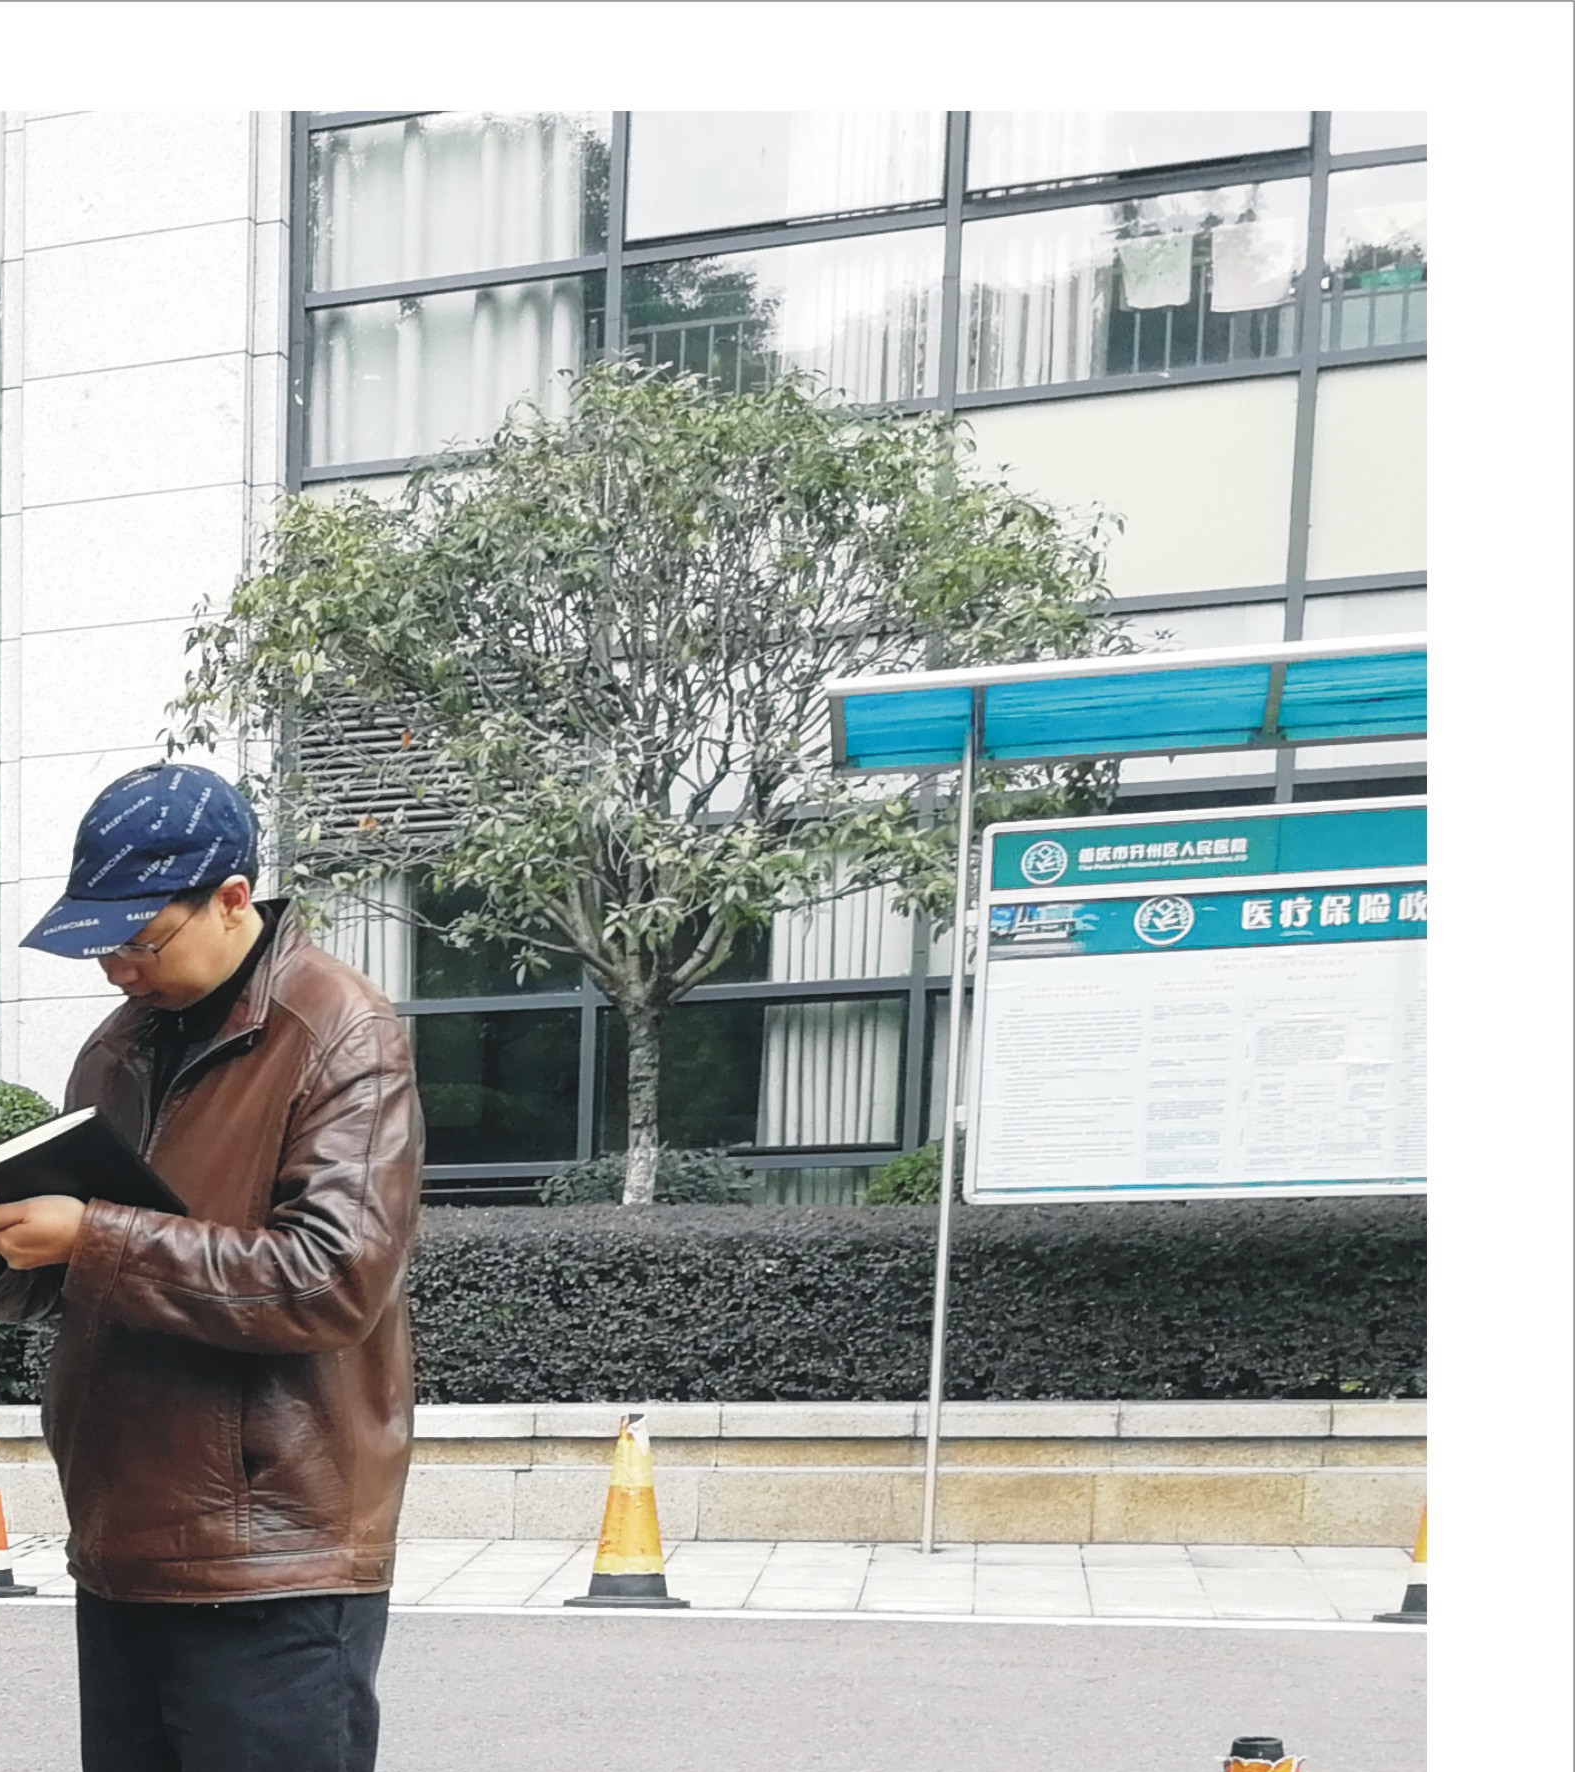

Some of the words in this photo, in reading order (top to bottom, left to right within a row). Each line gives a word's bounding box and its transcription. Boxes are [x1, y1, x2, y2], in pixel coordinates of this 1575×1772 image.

[1241, 891, 1427, 930] 医疗保险政
